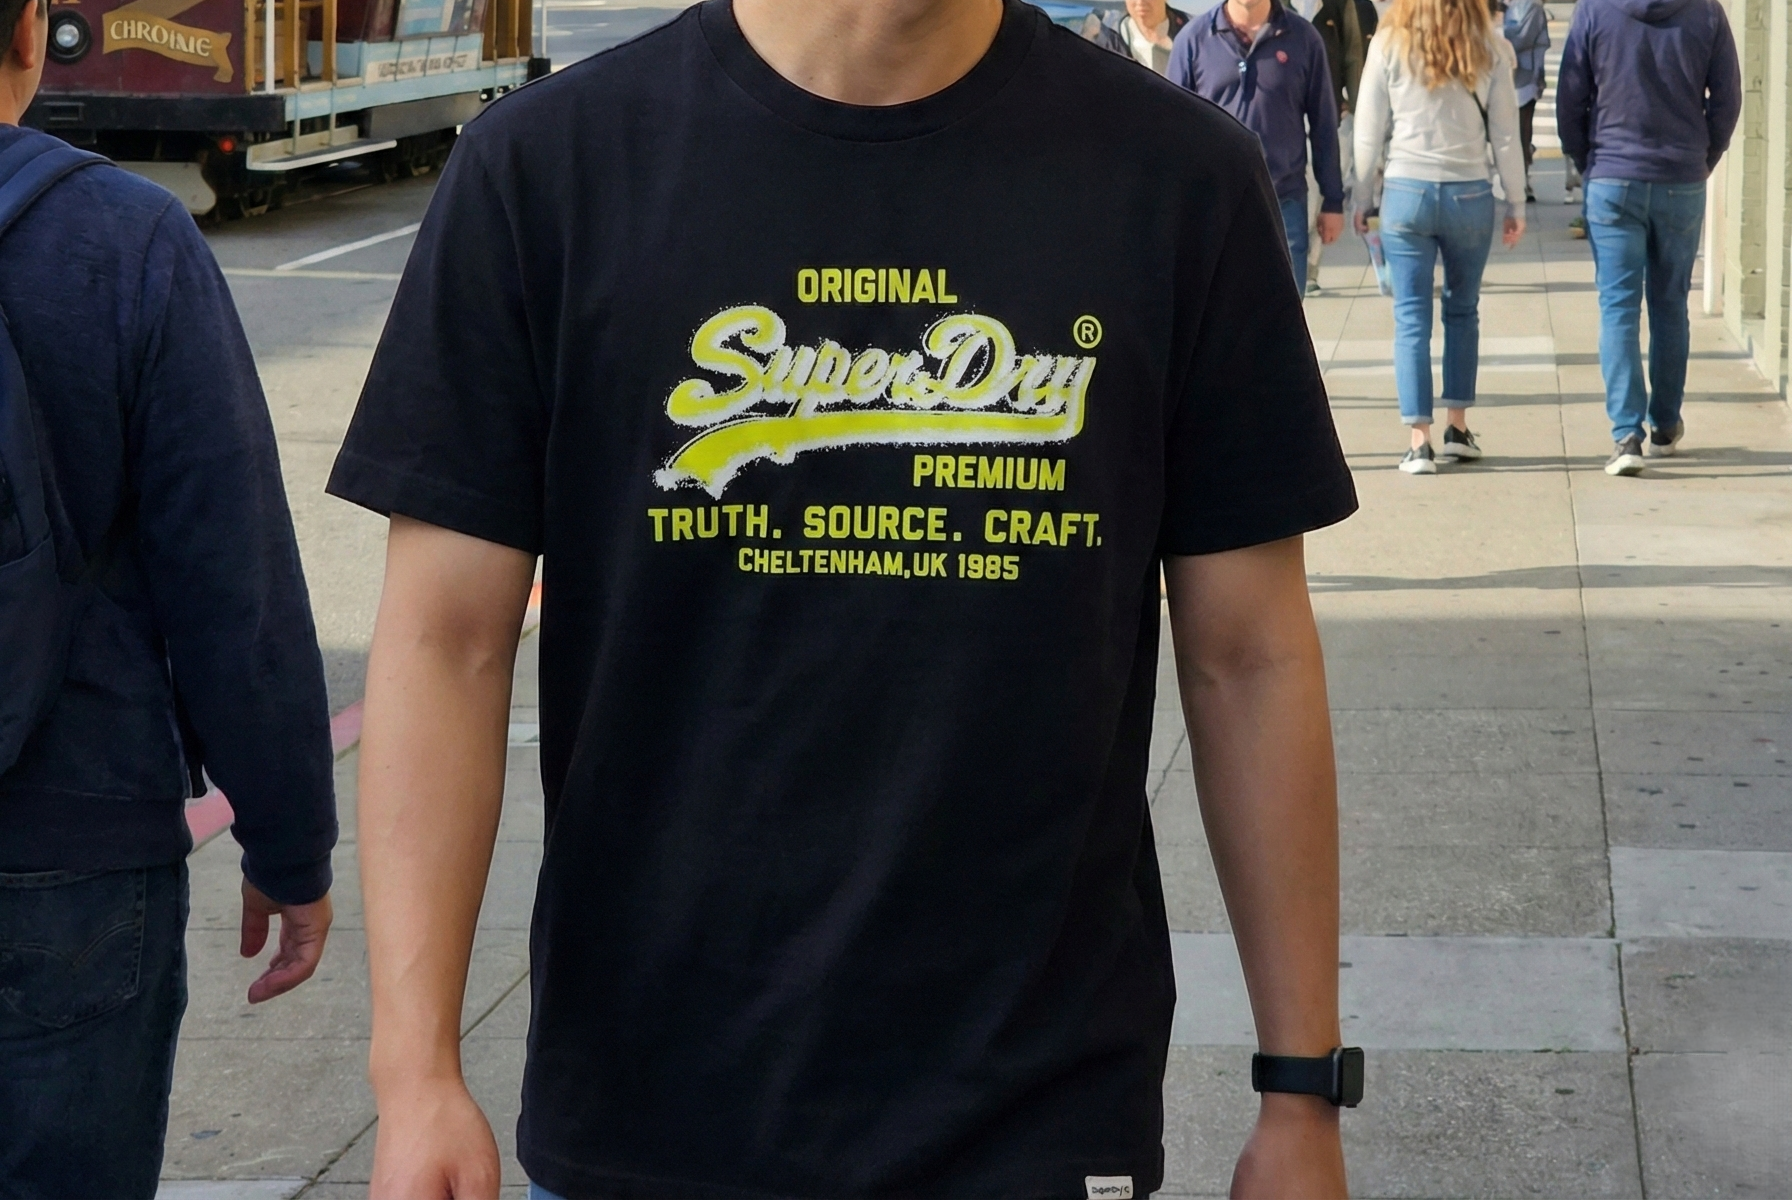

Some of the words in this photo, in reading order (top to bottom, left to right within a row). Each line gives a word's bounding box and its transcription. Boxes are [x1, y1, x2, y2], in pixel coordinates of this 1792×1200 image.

[797, 268, 958, 303] ORIGINAL
[913, 455, 1066, 491] PREMIUM
[648, 505, 782, 542] TRUTH.
[803, 506, 962, 542] SOURCE.
[984, 510, 1102, 547] CRAFT.
[958, 554, 1020, 581] 1985
